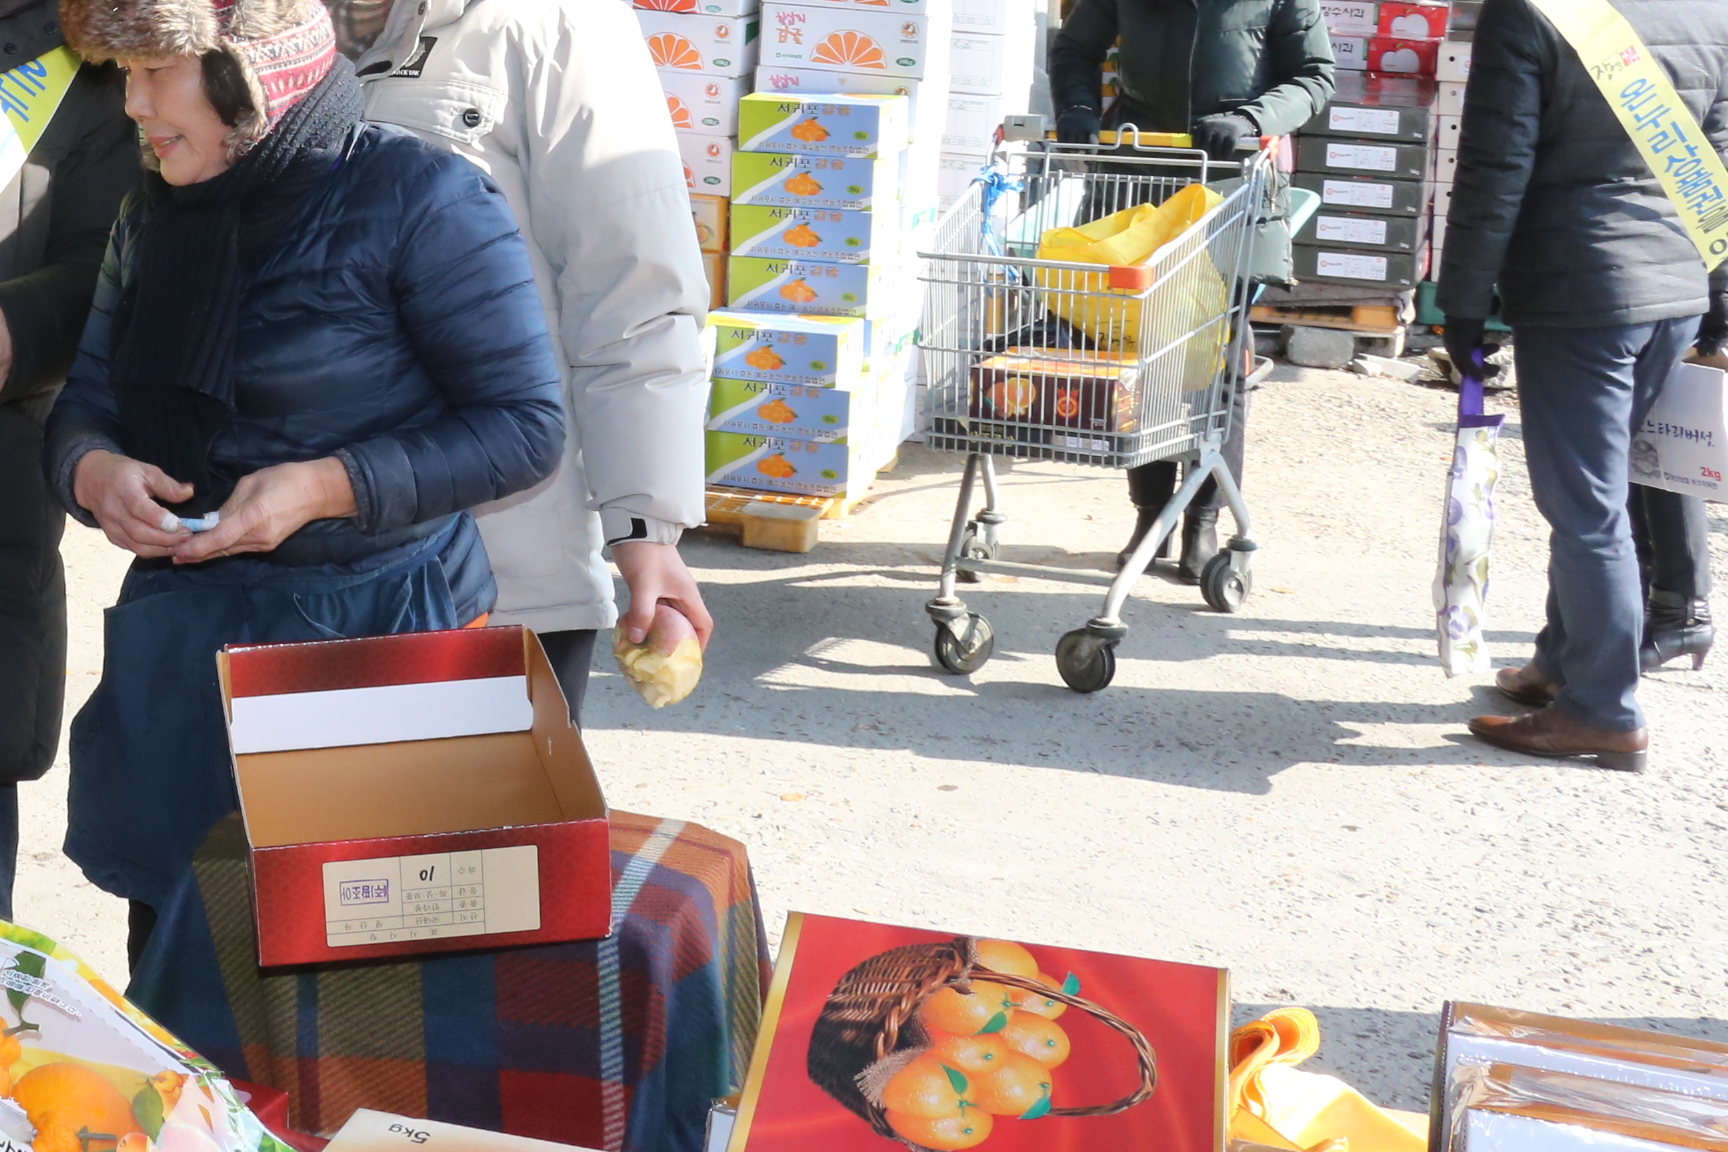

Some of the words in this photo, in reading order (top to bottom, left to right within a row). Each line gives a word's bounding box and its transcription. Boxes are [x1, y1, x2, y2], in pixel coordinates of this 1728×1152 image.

[777, 103, 819, 115] 서귀포
[769, 157, 812, 169] 서귀포
[768, 208, 812, 221] 서귀포
[765, 263, 808, 276] 서귀포
[730, 329, 774, 343] 서귀포
[743, 382, 787, 396] 서귀포
[742, 436, 786, 451] 서귀포
[1699, 466, 1722, 482] 2kg
[418, 865, 436, 882] 10
[387, 1123, 431, 1145] 5kg
